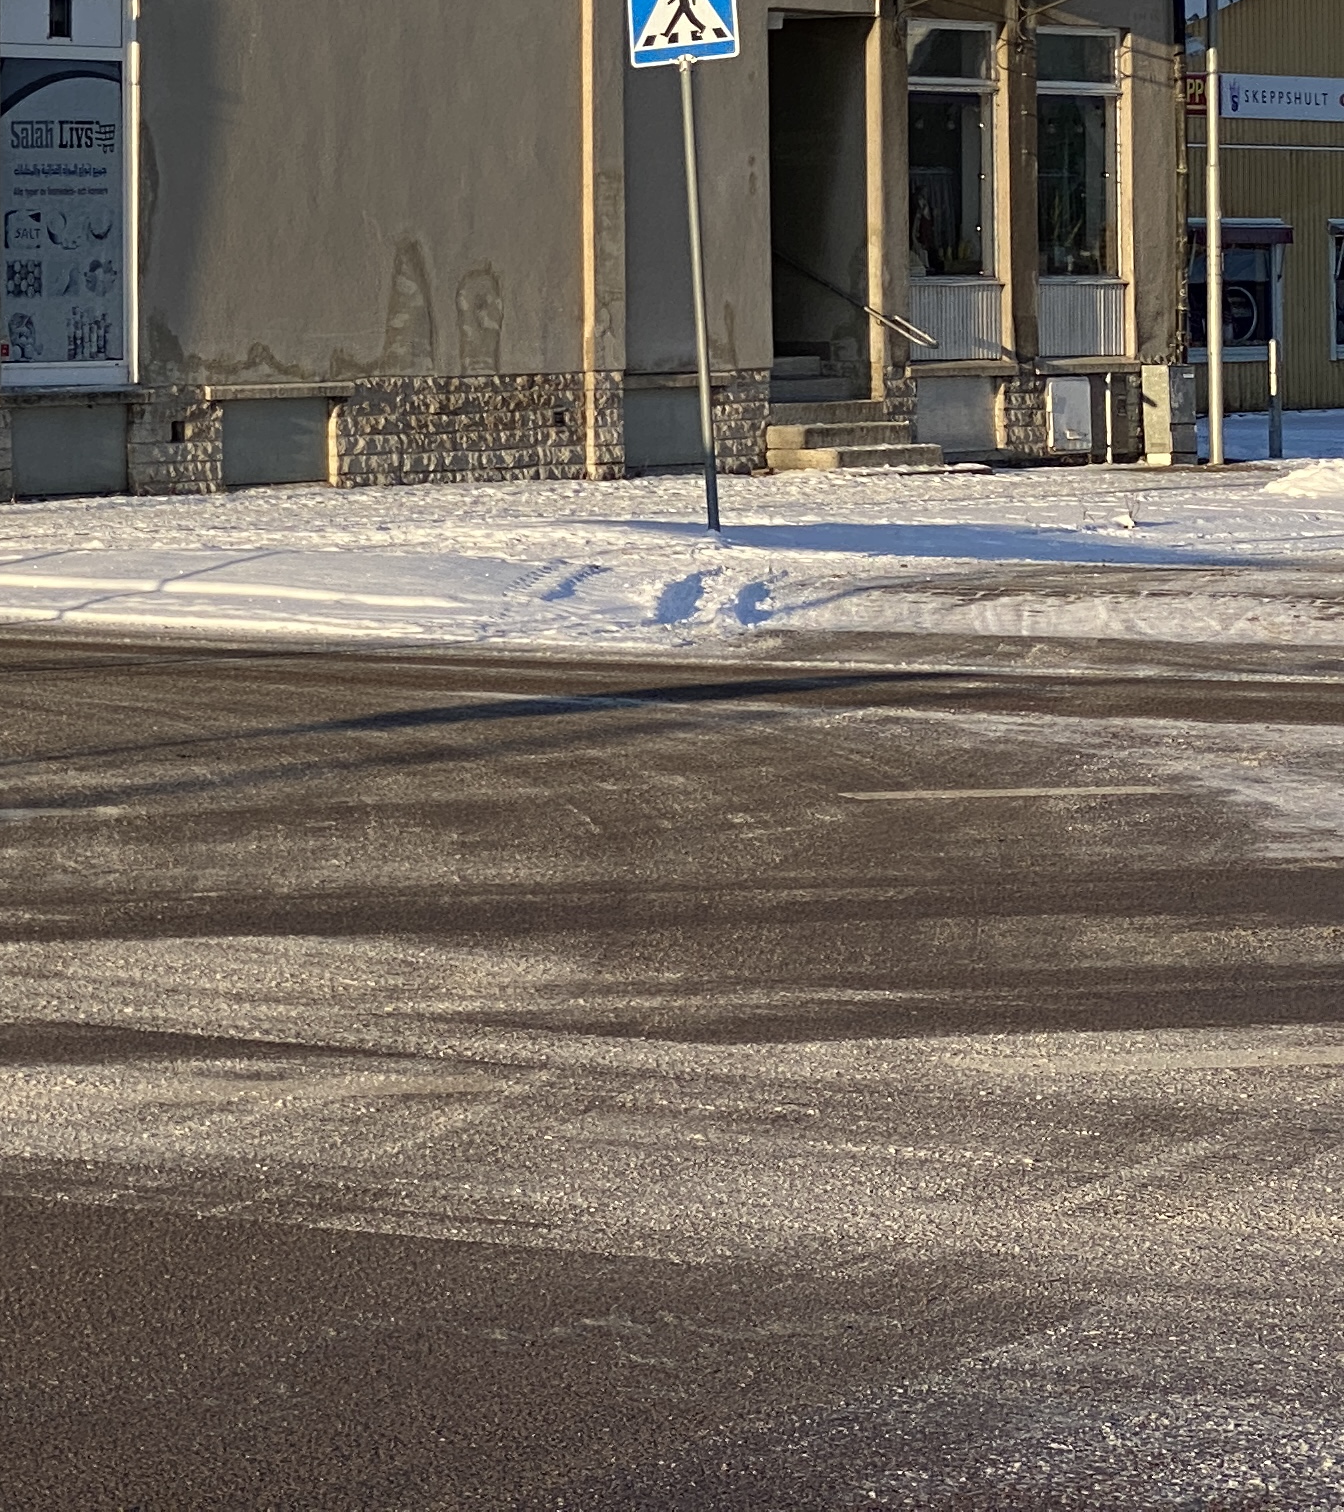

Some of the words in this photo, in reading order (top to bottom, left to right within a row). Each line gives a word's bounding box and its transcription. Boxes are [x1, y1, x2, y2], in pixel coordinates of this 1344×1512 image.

[1244, 89, 1329, 106] SKEPPSHULT
[10, 120, 55, 149] Salah
[58, 120, 95, 149] Livs
[14, 228, 41, 239] SALT
